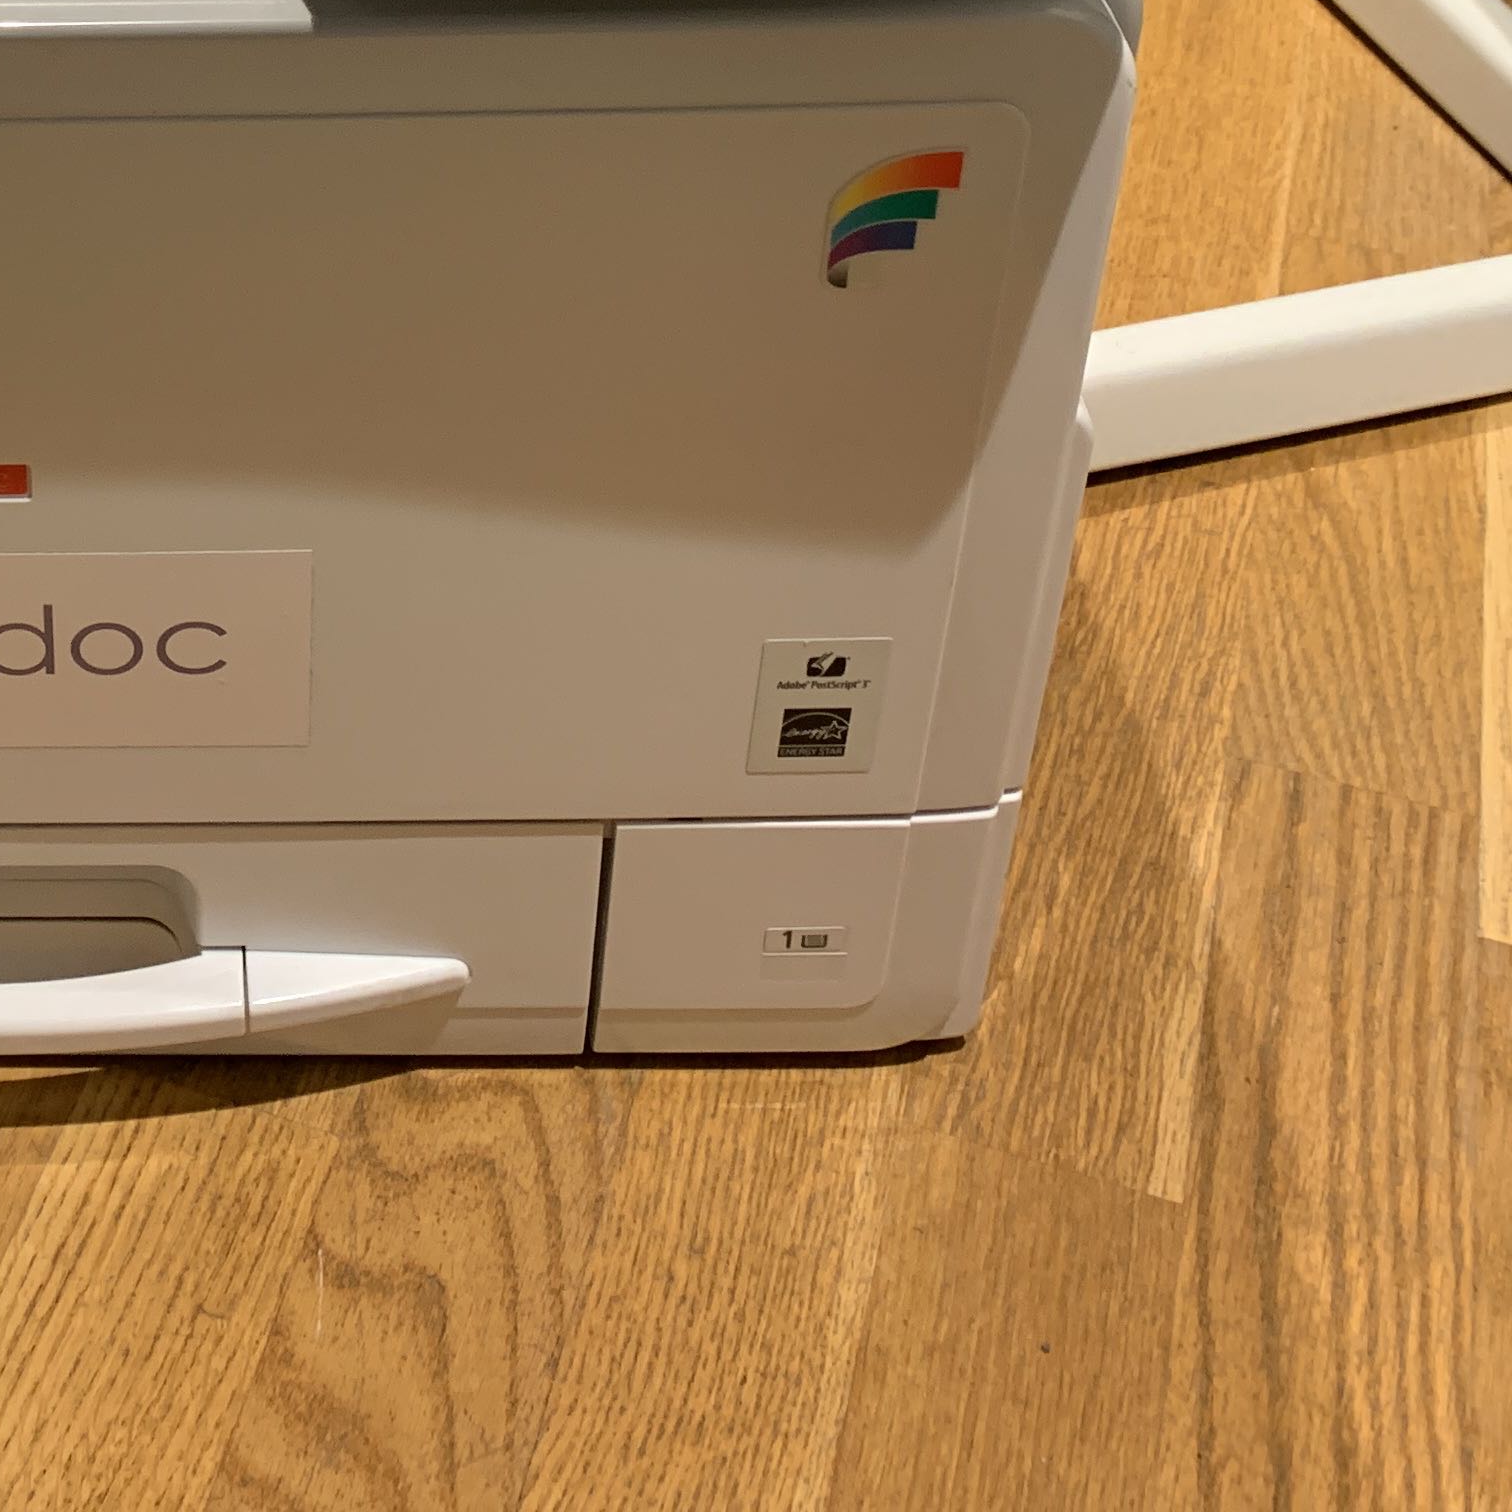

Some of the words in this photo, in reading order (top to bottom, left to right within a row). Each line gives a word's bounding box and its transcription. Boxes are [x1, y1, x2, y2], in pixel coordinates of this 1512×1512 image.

[779, 747, 817, 756] ENERGY
[818, 747, 843, 756] STAR
[781, 930, 793, 950] 1
